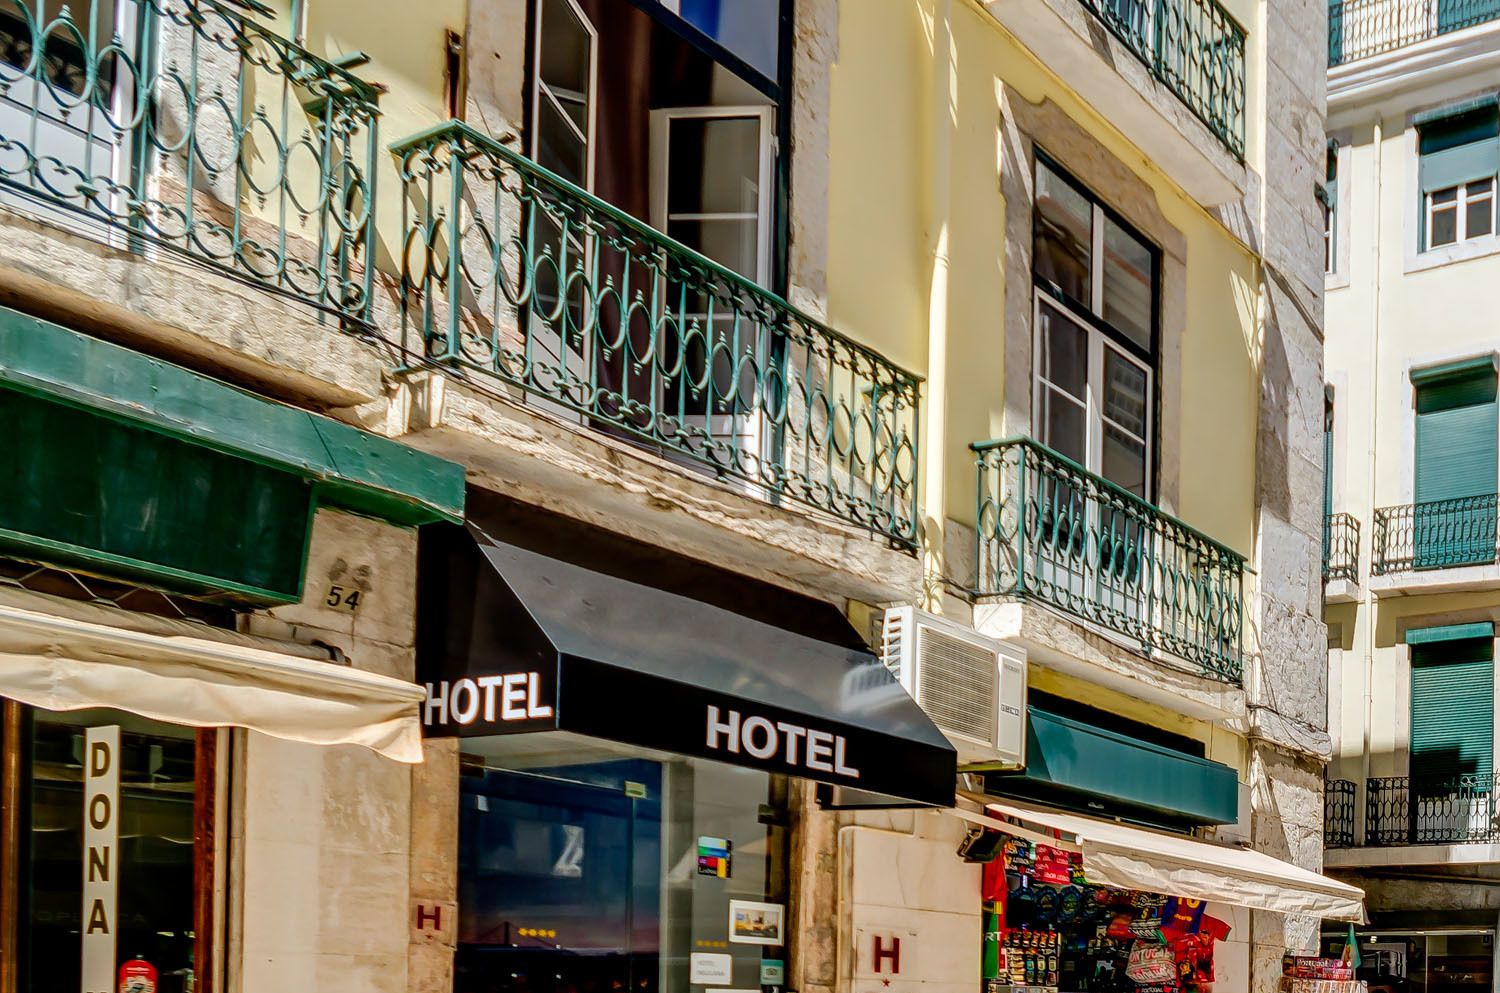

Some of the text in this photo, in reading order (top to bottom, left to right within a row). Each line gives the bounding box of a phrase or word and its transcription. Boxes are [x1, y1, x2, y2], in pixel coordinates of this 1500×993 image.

[327, 586, 360, 610] 54
[424, 672, 552, 725] HOTEL
[706, 705, 860, 778] HOTEL
[87, 742, 111, 934] DONA
[417, 904, 440, 930] H
[873, 935, 900, 974] H
